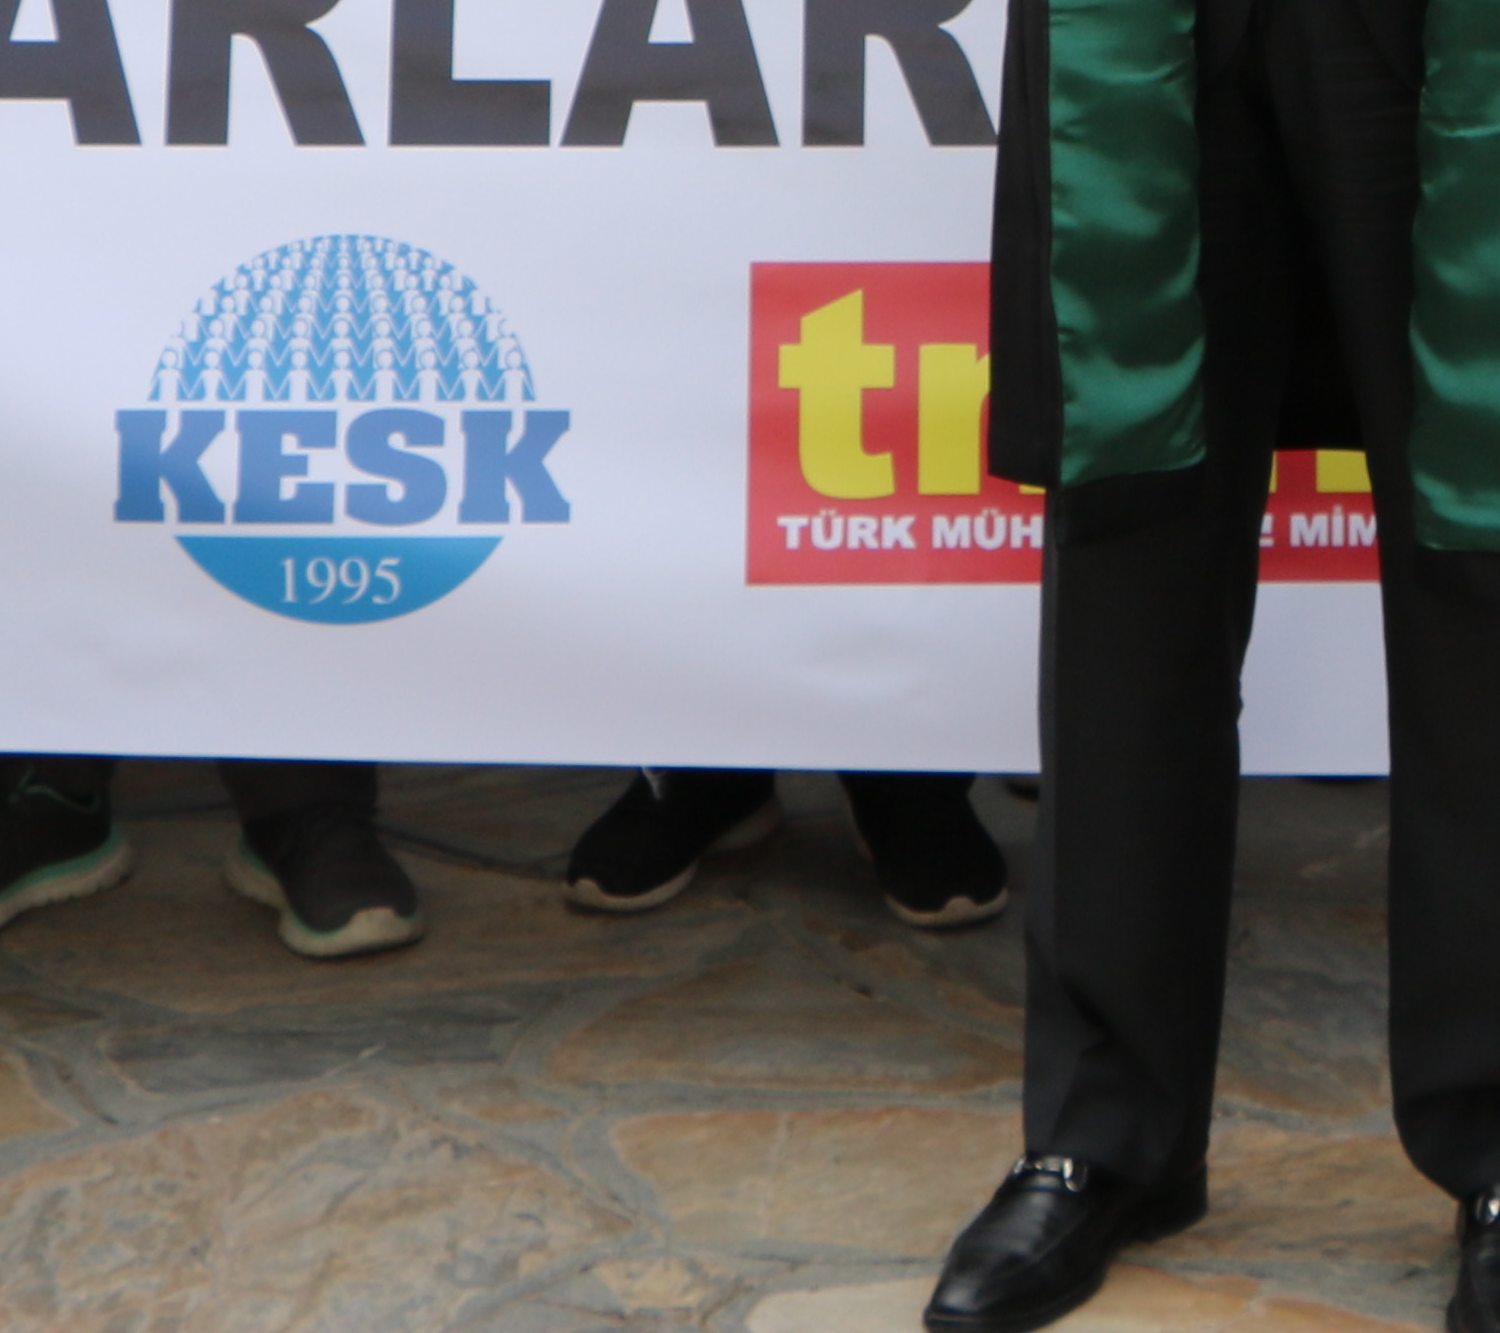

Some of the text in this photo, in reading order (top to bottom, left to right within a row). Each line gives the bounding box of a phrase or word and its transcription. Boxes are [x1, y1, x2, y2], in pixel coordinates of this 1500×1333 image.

[113, 407, 571, 527] KESK
[777, 508, 916, 550] TÜRK
[280, 556, 403, 605] 1995
